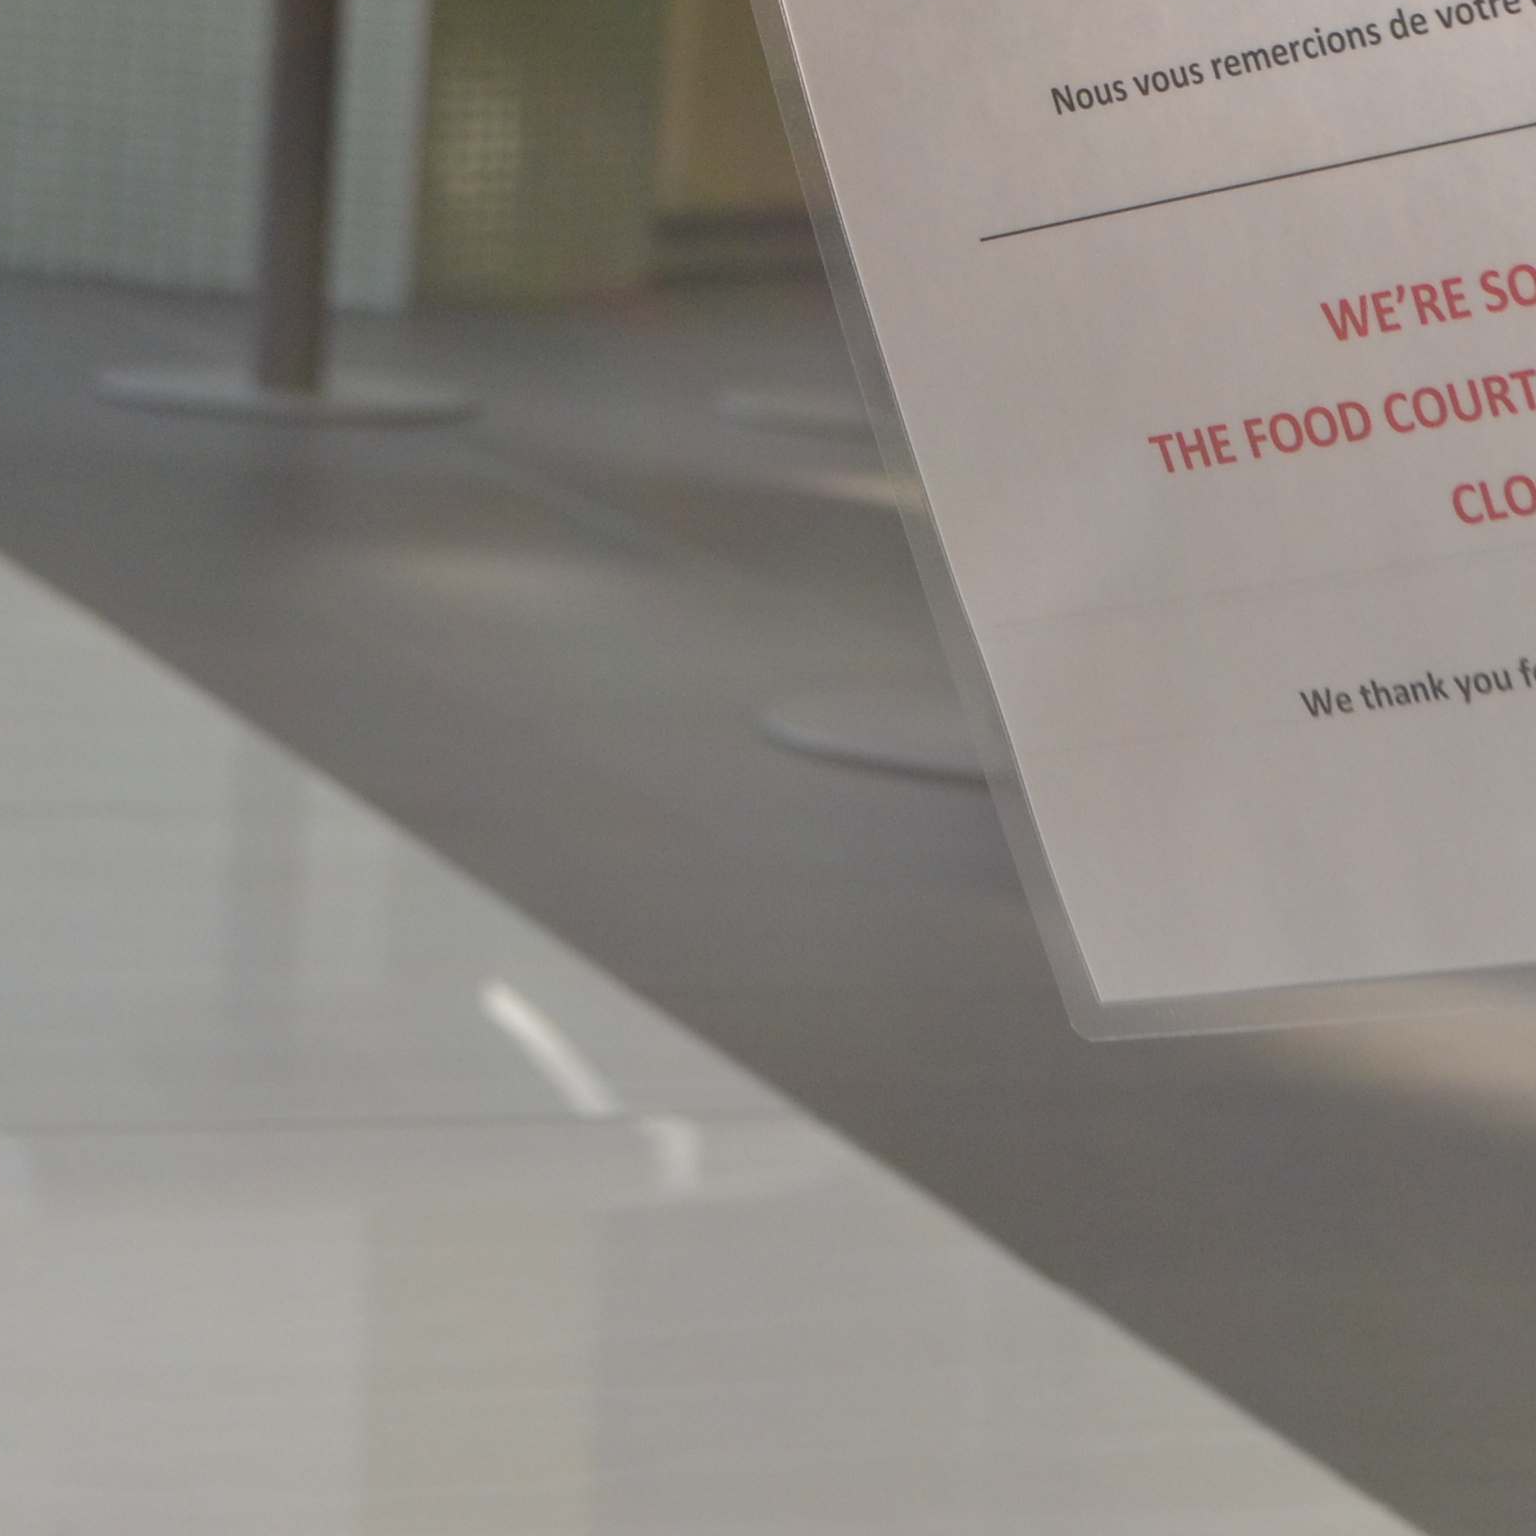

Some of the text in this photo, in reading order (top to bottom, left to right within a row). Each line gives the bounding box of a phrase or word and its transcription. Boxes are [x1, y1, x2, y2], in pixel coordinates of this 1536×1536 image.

[1050, 79, 1129, 116] Nous
[1131, 62, 1205, 97] vous
[1210, 22, 1383, 81] remercions
[1388, 7, 1430, 41] de
[1147, 423, 1238, 474] THE
[1242, 400, 1373, 459] FOOD
[1298, 687, 1355, 719] We
[1358, 671, 1450, 711] thank
[1452, 669, 1514, 705] you
